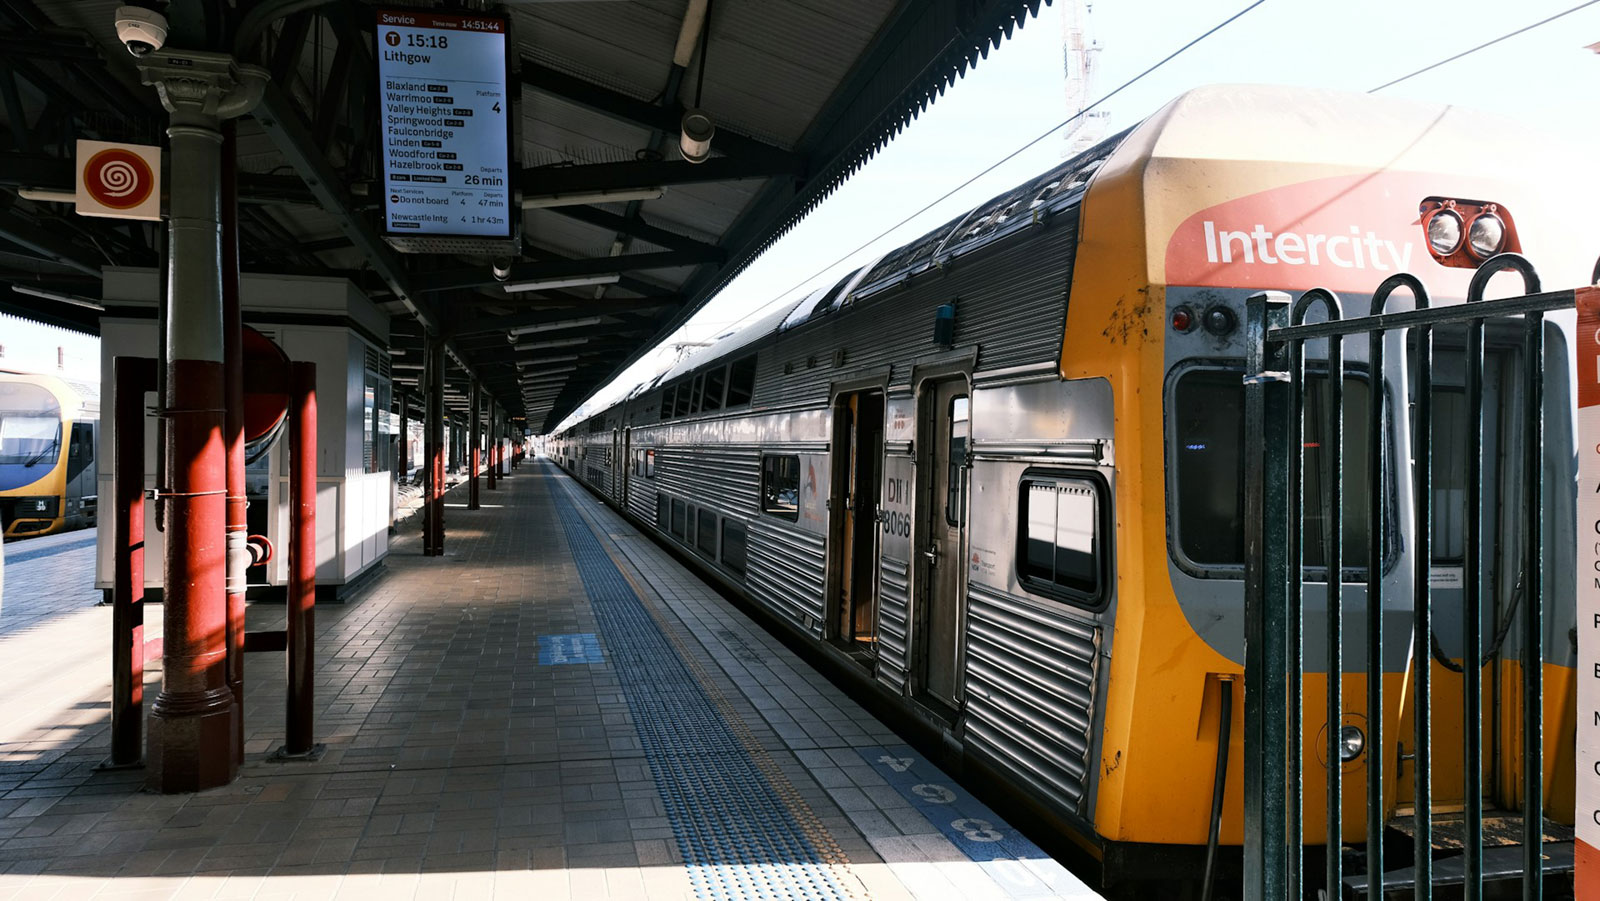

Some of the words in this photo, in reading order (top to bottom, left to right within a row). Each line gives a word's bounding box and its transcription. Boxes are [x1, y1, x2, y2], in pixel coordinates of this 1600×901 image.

[383, 14, 415, 24] Service
[462, 20, 499, 30] 14:51:44
[407, 34, 448, 48] 15:18
[384, 50, 431, 65] Lithgow
[386, 81, 426, 92] Blaxland
[387, 93, 432, 103] Warrimoo
[387, 104, 415, 115] Valley
[416, 106, 452, 116] Heights
[492, 102, 501, 114] 4
[388, 116, 442, 127] Springwood
[388, 127, 454, 139] Faulconbridge
[389, 138, 420, 148] Linden
[389, 149, 435, 160] Woodford
[390, 160, 442, 170] Hazelbrook
[464, 175, 480, 185] 26
[482, 176, 503, 186] min
[426, 196, 448, 205] board
[392, 213, 431, 221] Newcastle
[432, 214, 448, 223] Intg
[1204, 221, 1412, 272] Intercity
[884, 510, 910, 538] 8066
[951, 818, 1004, 842] 8
